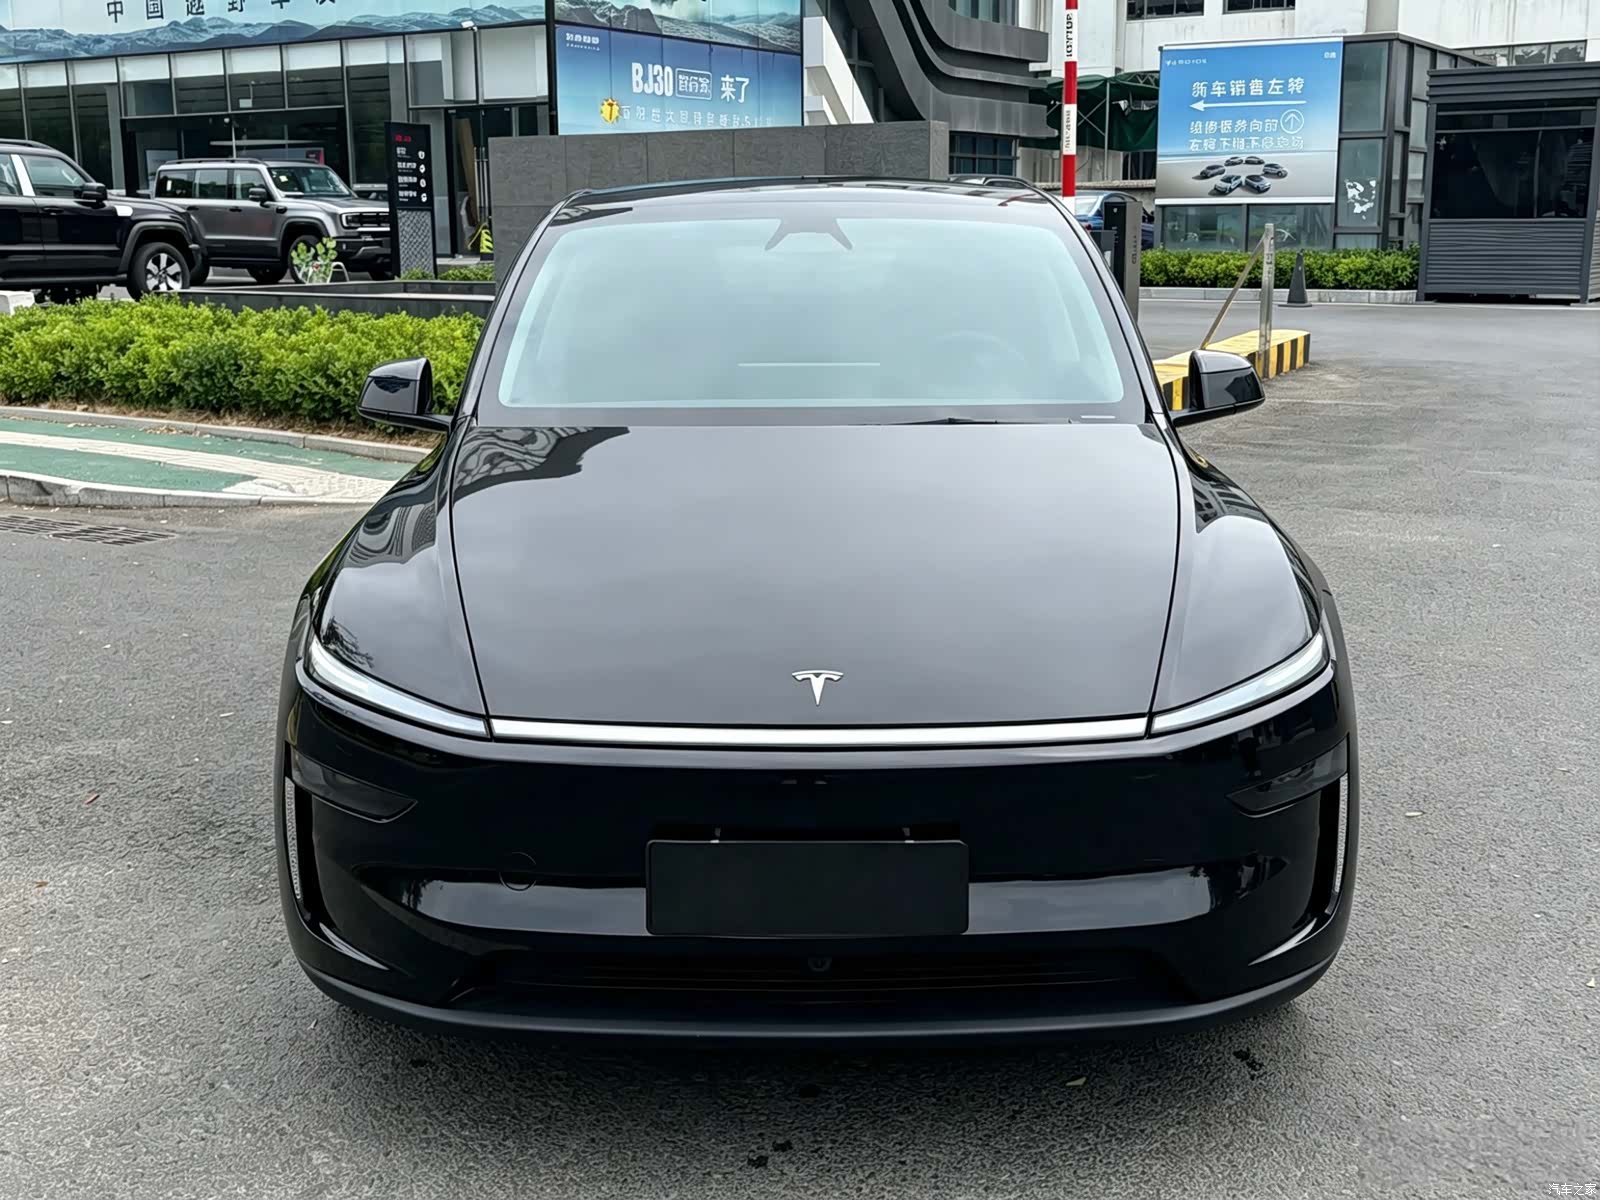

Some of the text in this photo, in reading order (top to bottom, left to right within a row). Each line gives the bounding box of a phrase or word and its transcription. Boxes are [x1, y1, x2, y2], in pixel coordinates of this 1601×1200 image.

[631, 62, 674, 97] BJ30
[720, 74, 750, 104] 来了
[1191, 77, 1305, 98] 新车销售左转
